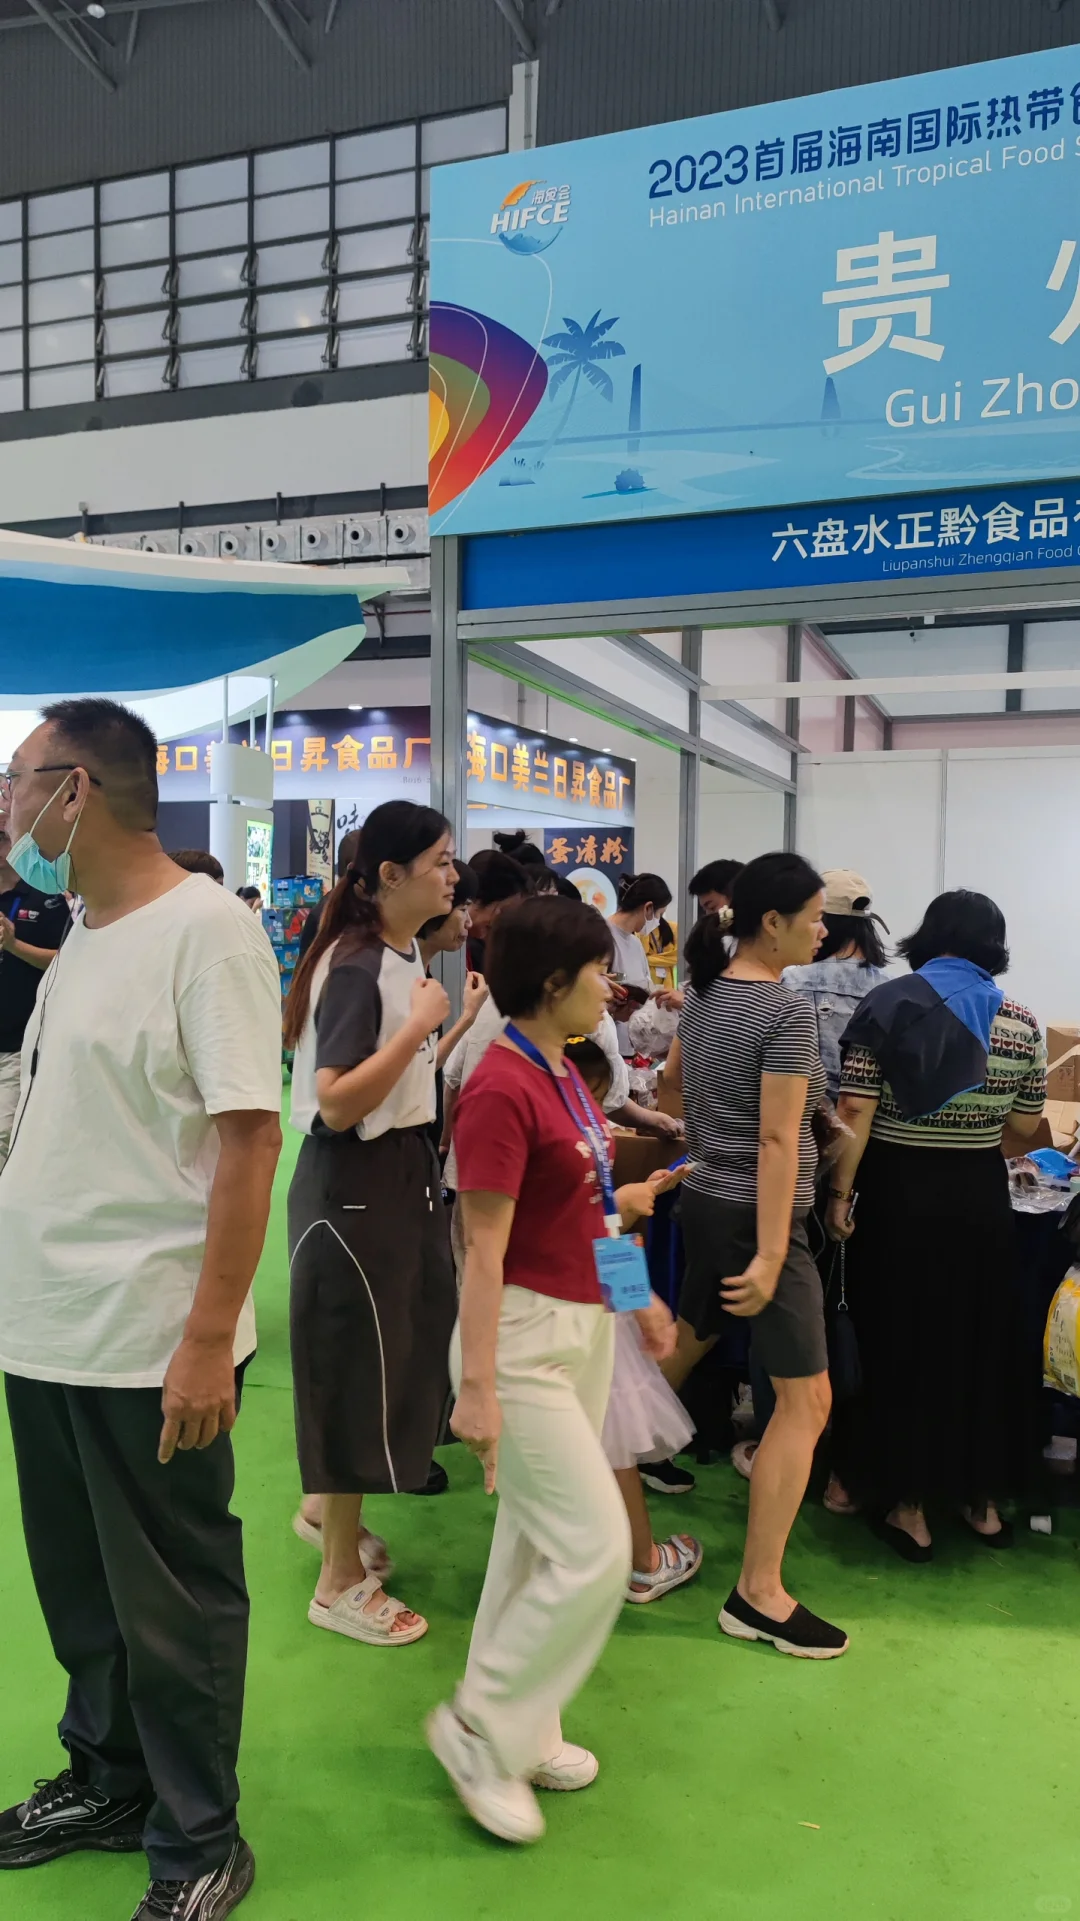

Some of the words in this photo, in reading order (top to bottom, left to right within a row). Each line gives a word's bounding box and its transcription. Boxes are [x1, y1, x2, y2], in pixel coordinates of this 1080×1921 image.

[649, 82, 1080, 199] 2023首届海南国际热带
[650, 201, 726, 228] Hainan
[735, 169, 884, 214] International
[892, 150, 992, 186] Tropical
[1002, 138, 1065, 169] Food
[490, 200, 571, 234] HIFCE
[885, 380, 962, 427] Gui
[980, 372, 1079, 418] Zho
[771, 497, 1080, 562] 六盘水正黔食品
[882, 554, 955, 573] Liupanshui
[958, 549, 1034, 566] Zhengqian
[1038, 544, 1073, 560] Food
